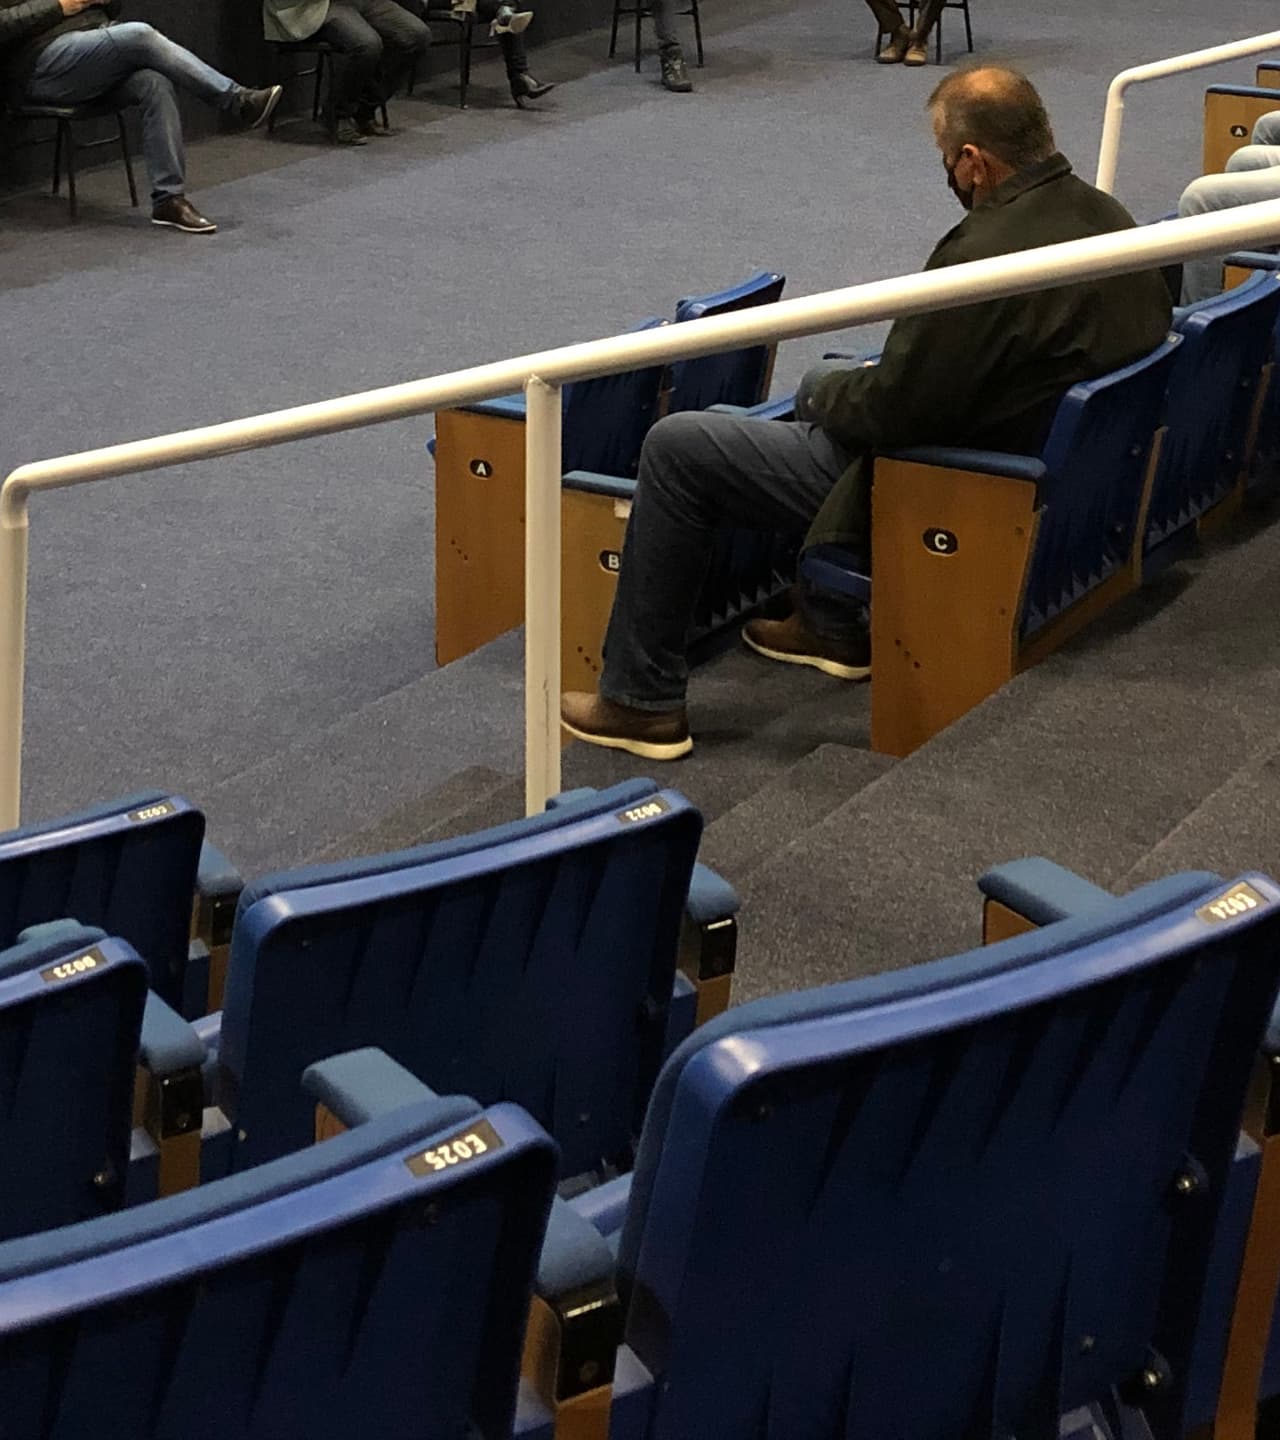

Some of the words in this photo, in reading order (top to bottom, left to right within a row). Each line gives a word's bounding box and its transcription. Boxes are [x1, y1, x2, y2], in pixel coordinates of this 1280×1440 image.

[1235, 127, 1243, 136] A
[476, 462, 487, 476] A
[934, 533, 948, 550] C
[608, 554, 619, 570] B
[137, 805, 168, 820] C022
[1209, 886, 1257, 919] E024
[424, 1134, 488, 1170] E025
